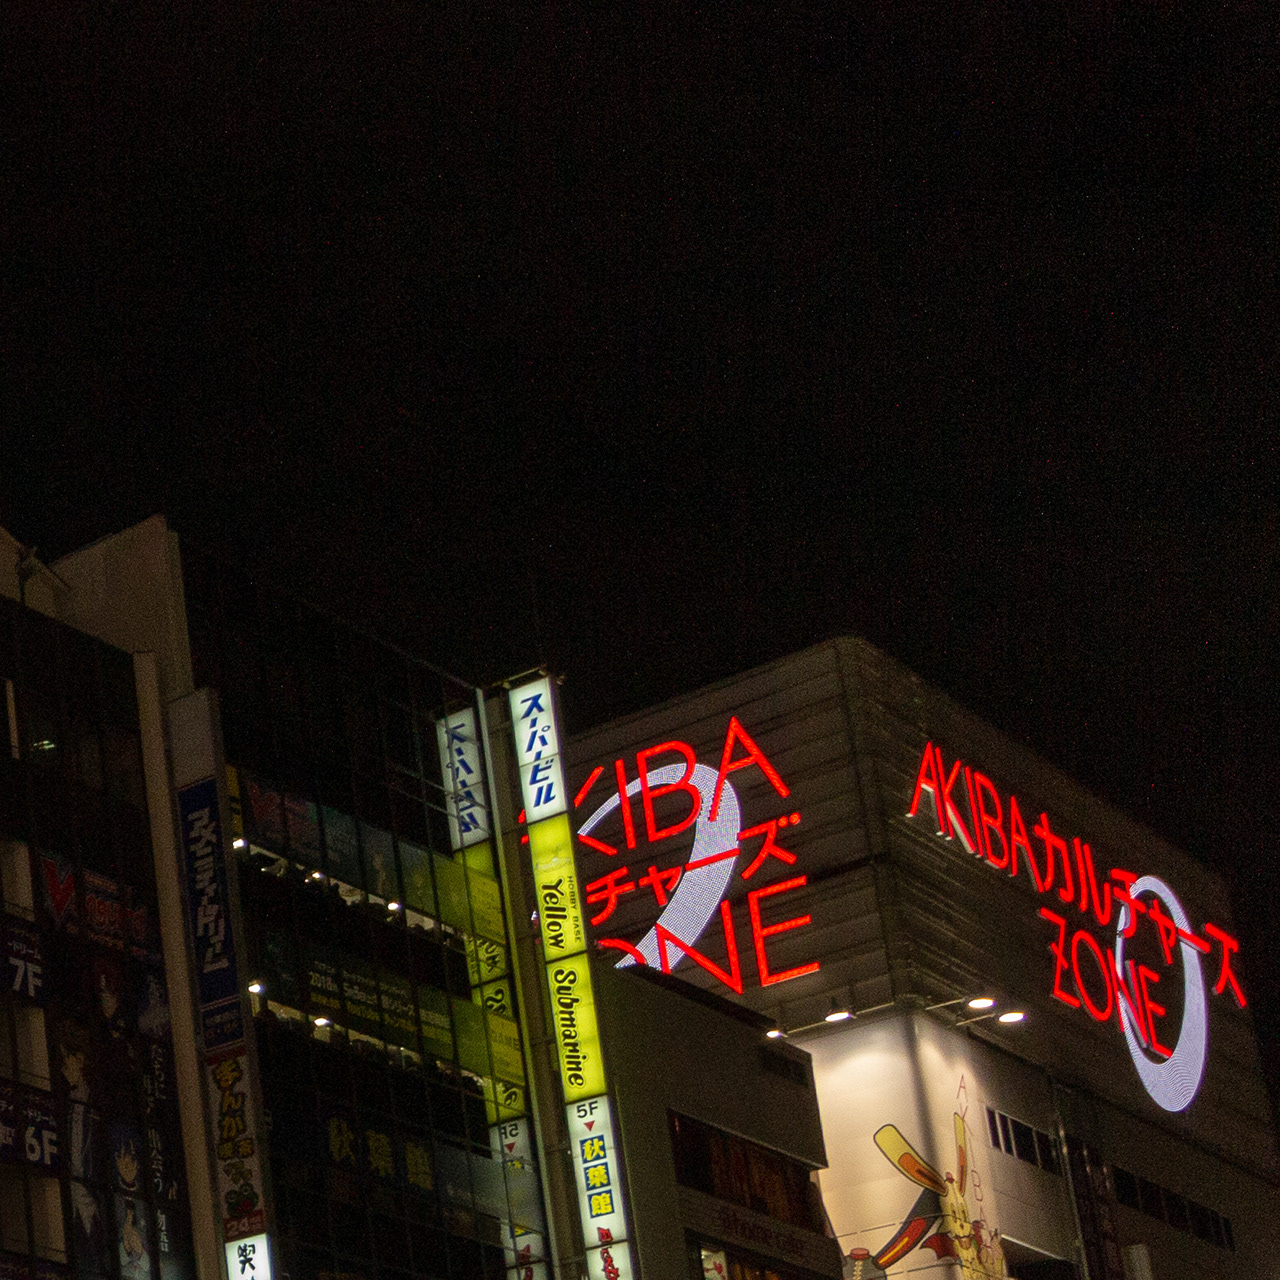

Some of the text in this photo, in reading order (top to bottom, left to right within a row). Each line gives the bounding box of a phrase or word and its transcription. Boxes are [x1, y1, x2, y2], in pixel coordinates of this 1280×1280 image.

[519, 692, 558, 808] スーパービル
[8, 956, 42, 998] 7F
[539, 878, 586, 1089] Yellow Submarine
[1039, 907, 1173, 1059] ZONE
[24, 1123, 59, 1166] 6F
[575, 1100, 600, 1119] 5F
